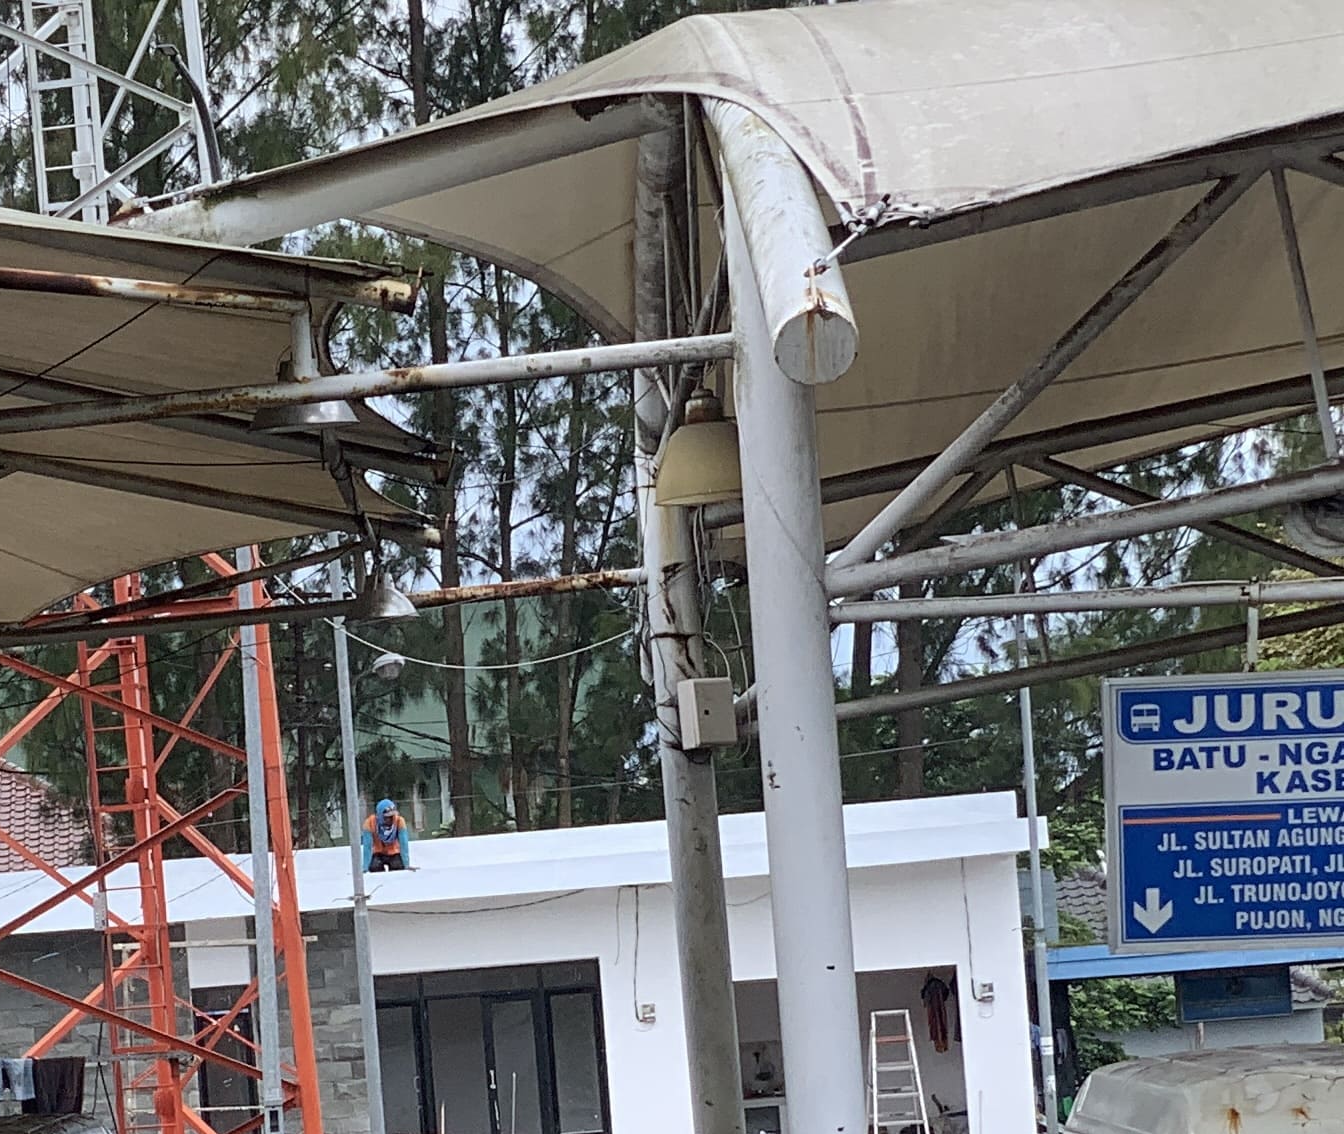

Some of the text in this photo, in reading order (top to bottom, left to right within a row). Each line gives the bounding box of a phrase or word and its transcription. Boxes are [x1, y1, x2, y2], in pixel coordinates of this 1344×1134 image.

[1172, 690, 1344, 734] JURU
[1153, 745, 1246, 771] BATU
[1287, 806, 1344, 825] LEW
[1157, 833, 1188, 852] JL.
[1194, 829, 1270, 850] SULTAN
[1173, 859, 1204, 878] JL.
[1210, 855, 1318, 877] SUROPATI,
[1194, 881, 1344, 904] JL. TRUNOJOY
[1236, 909, 1312, 931] PUJON,
